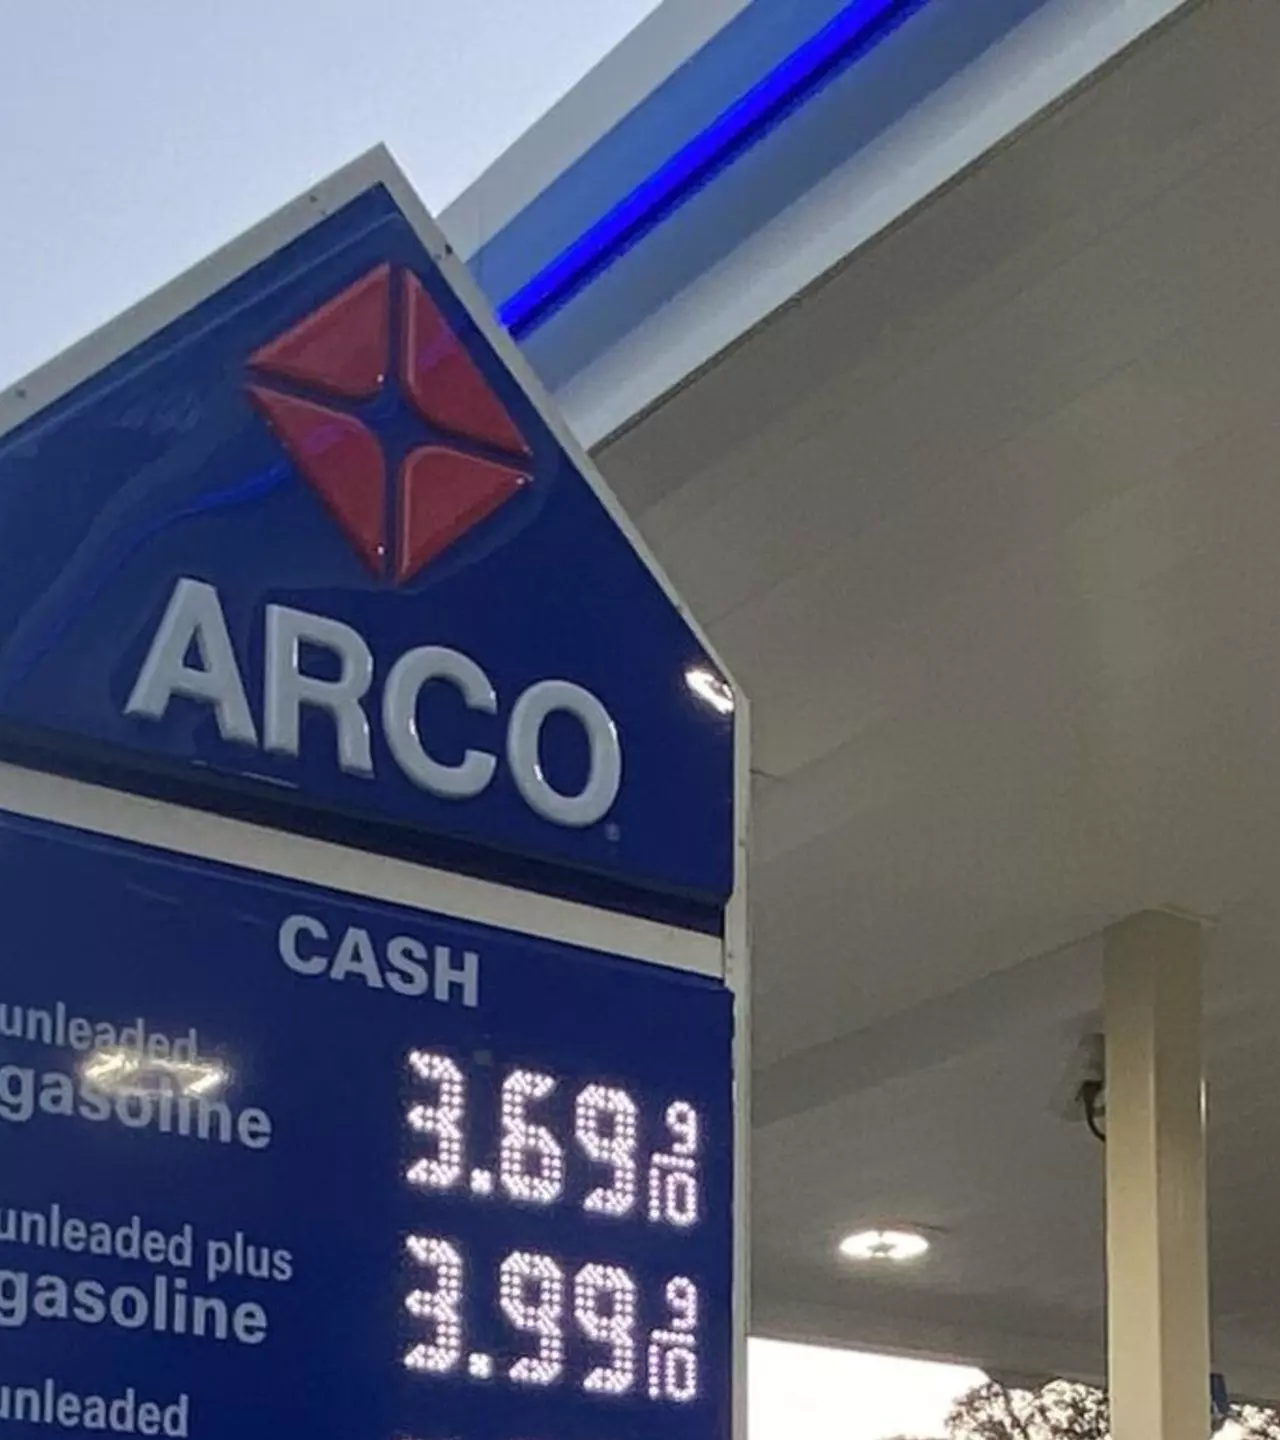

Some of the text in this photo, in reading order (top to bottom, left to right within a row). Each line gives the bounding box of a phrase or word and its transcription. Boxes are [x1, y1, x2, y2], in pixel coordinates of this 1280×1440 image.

[123, 576, 622, 829] ARCO
[278, 914, 480, 1007] CASH
[406, 1049, 637, 1218] 3.69
[207, 1231, 293, 1282] plus
[404, 1234, 637, 1393] 3.99
